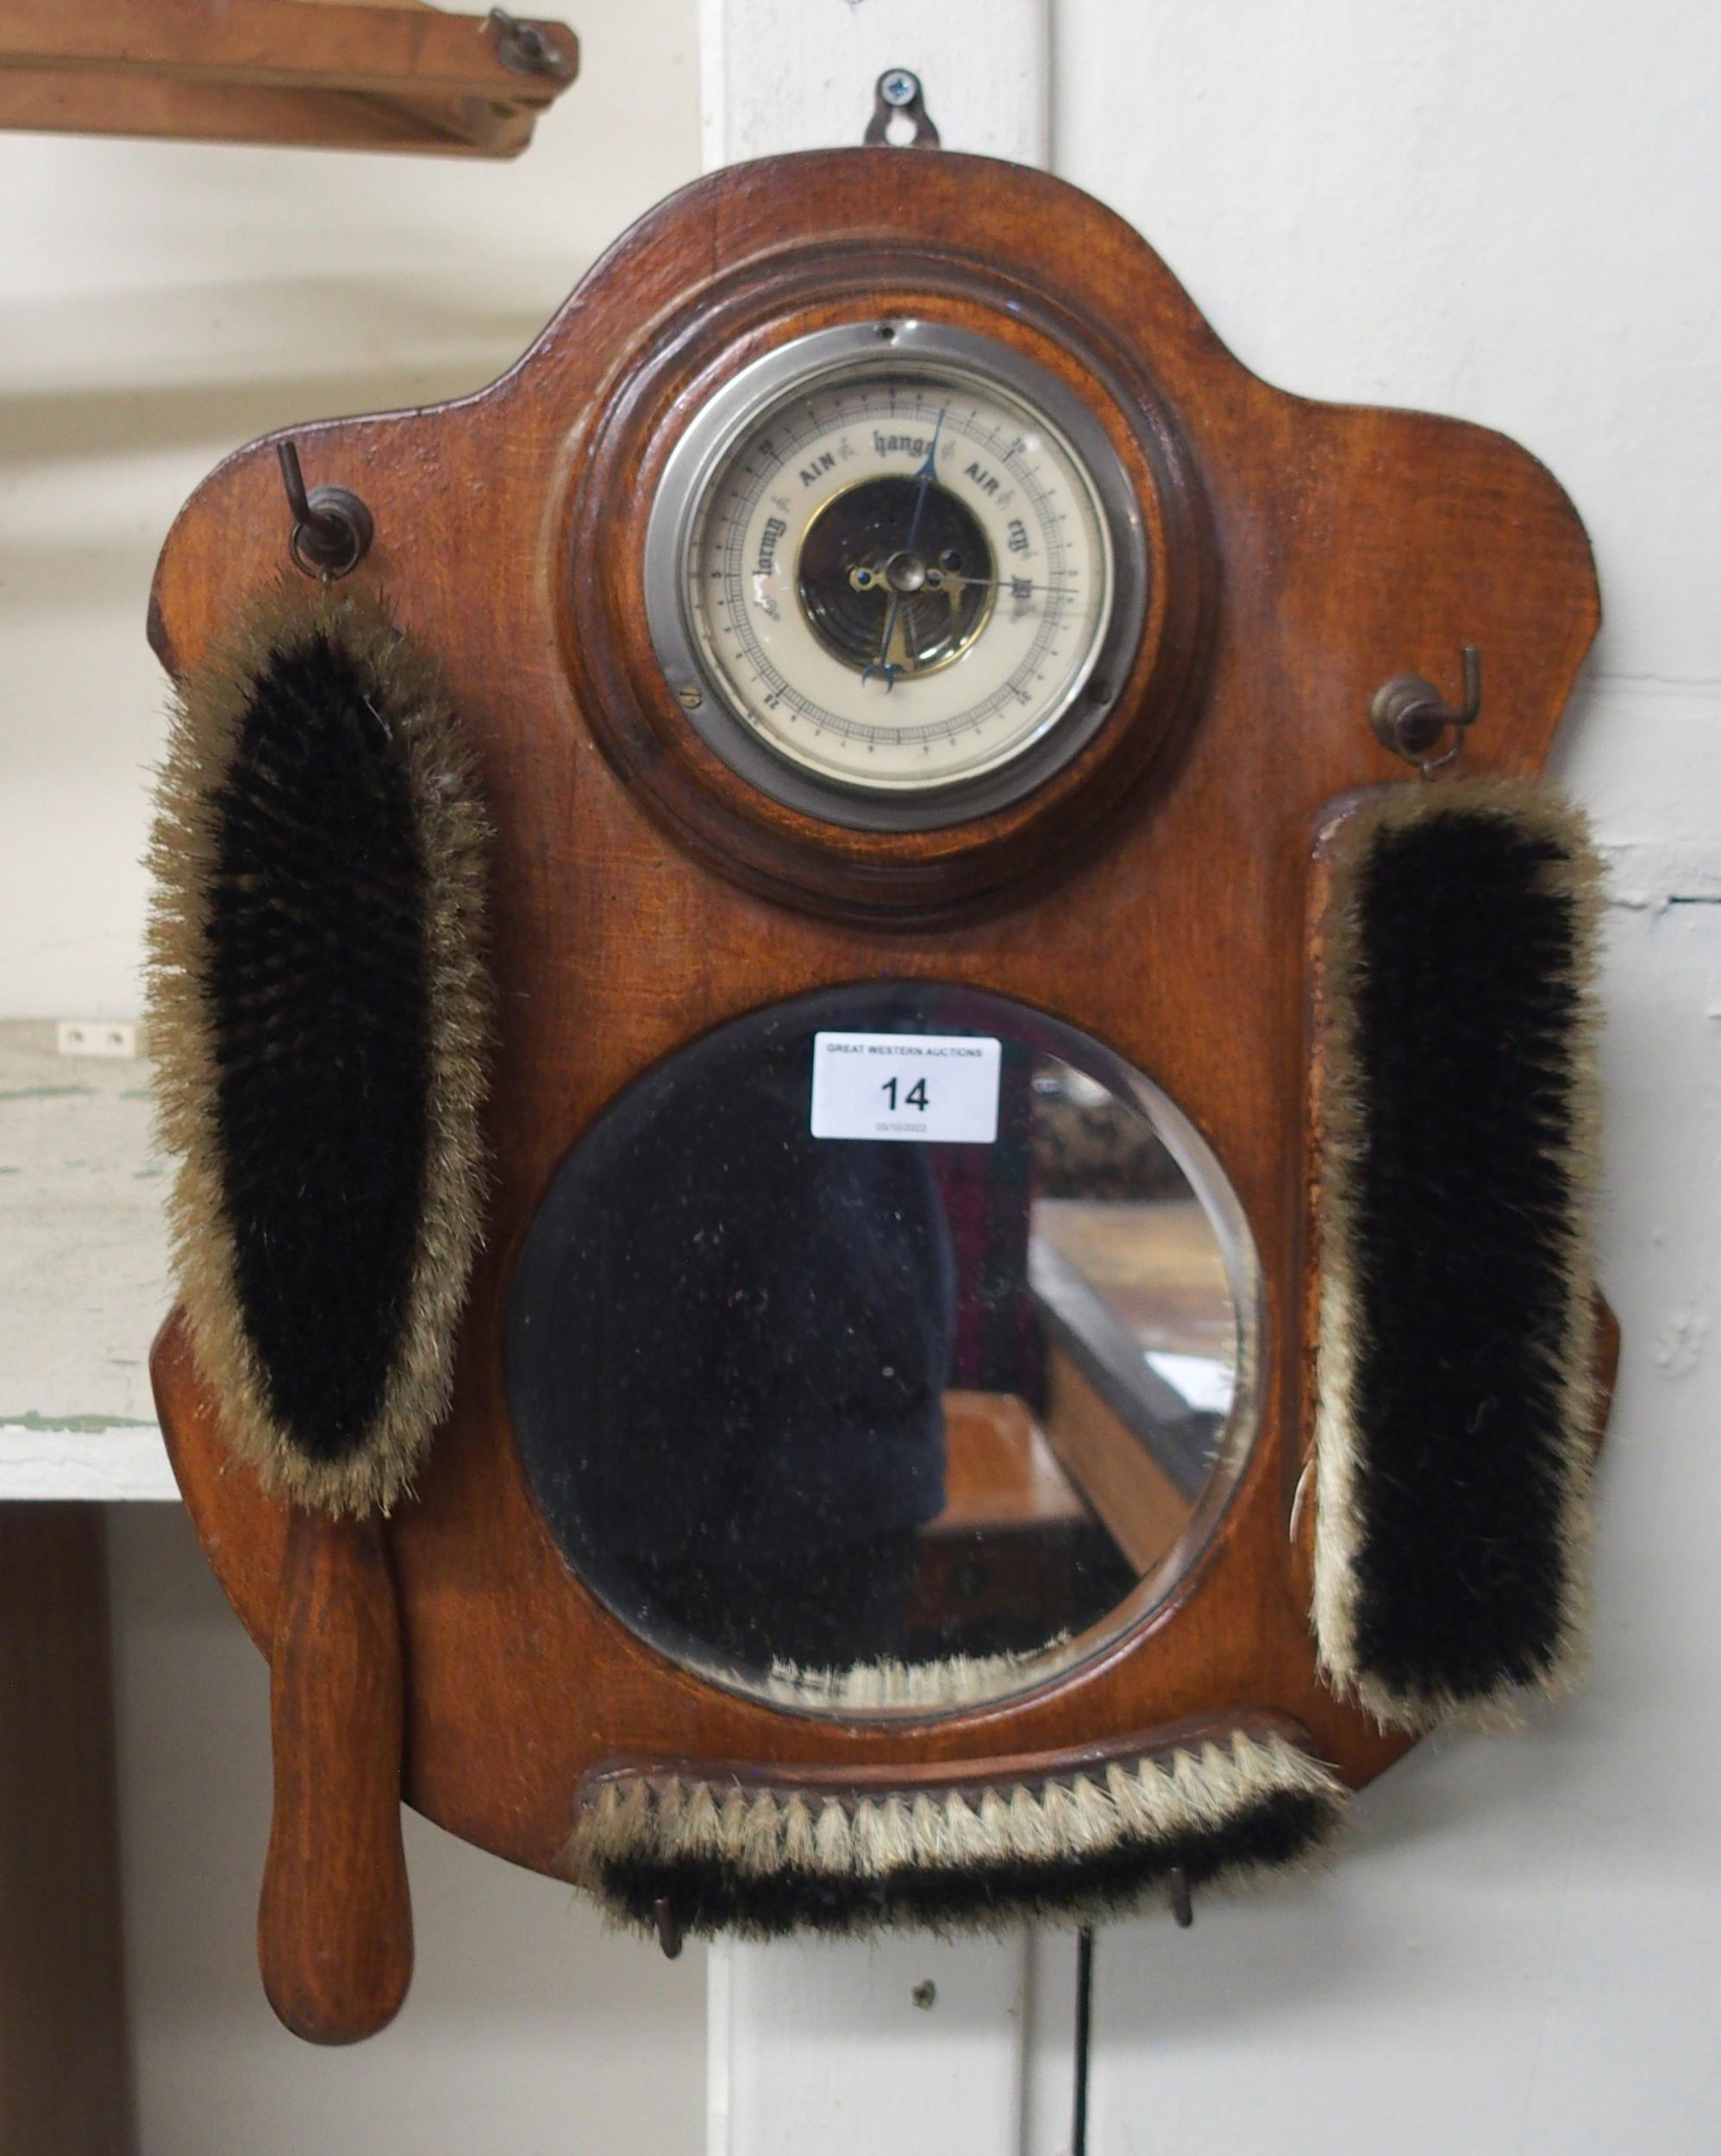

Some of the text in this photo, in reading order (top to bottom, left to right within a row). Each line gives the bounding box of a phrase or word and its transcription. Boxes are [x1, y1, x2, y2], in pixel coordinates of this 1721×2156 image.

[827, 1044, 982, 1057] GREAT WESTERN AUCTIONS
[881, 1076, 929, 1111] 14
